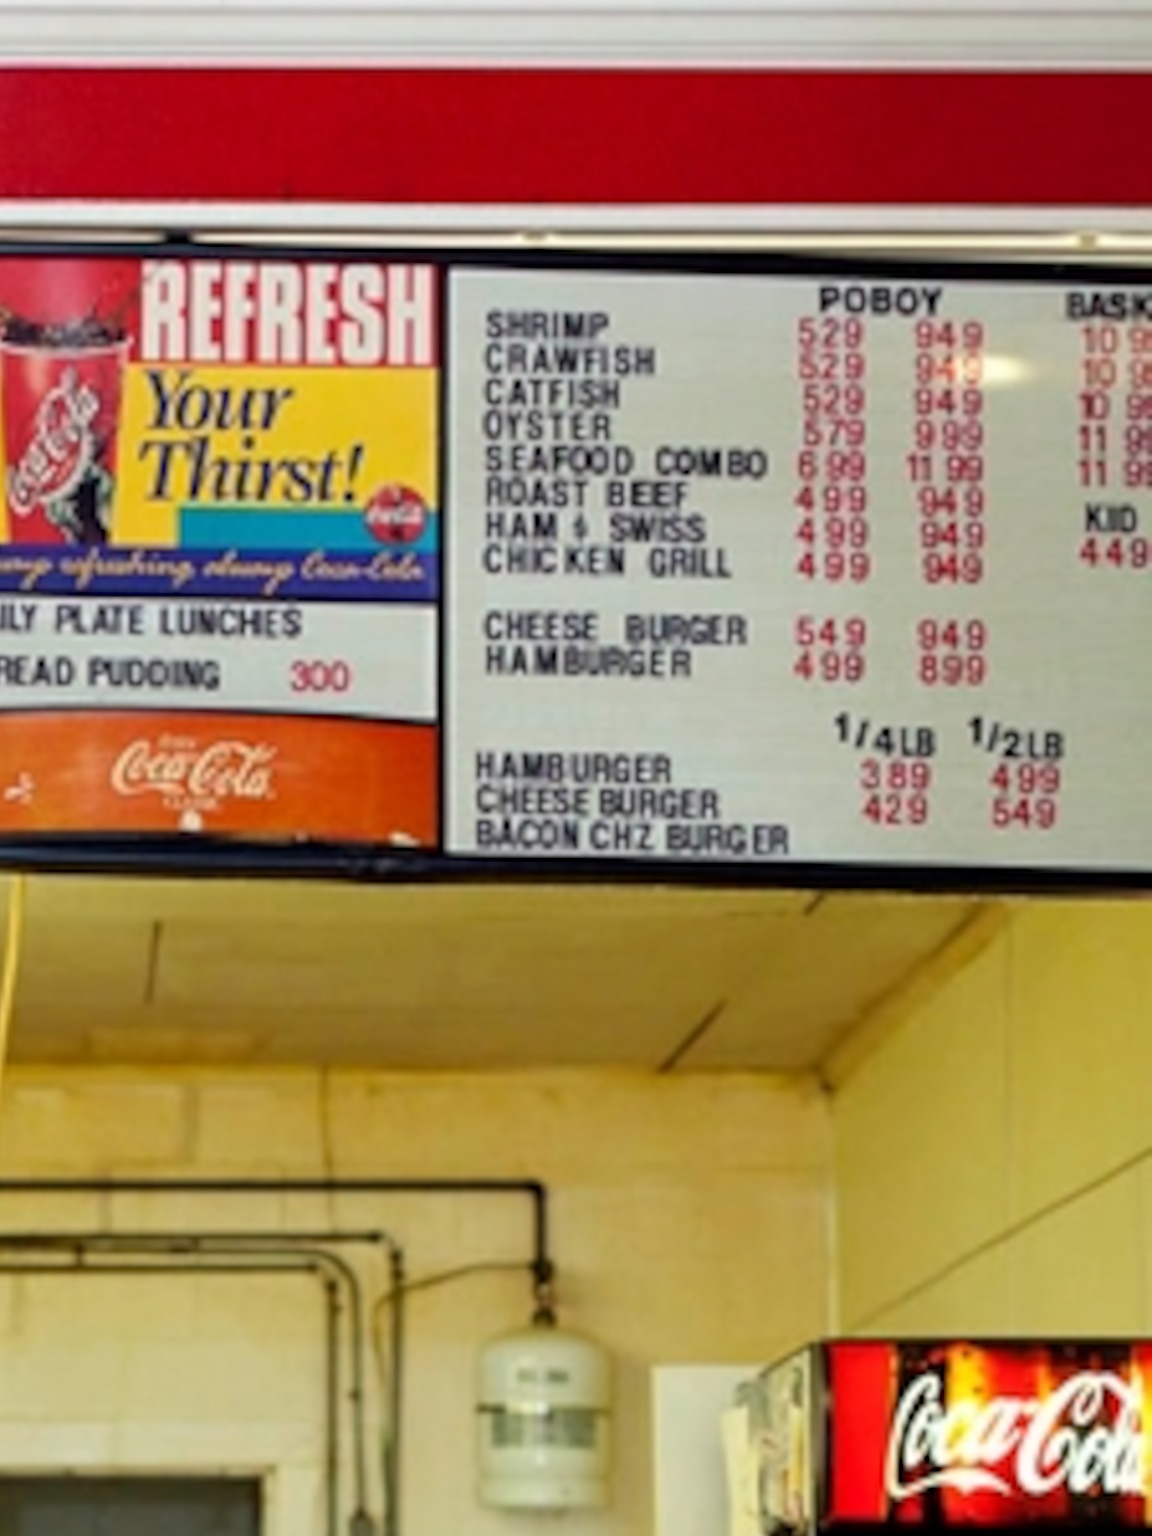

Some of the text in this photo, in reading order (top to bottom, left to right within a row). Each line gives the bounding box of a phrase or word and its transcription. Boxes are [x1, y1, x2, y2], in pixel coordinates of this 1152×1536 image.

[141, 260, 434, 366] REFRESH
[819, 286, 943, 316] POBOY
[485, 311, 610, 339] SHRIMP
[797, 317, 864, 350] 529
[914, 320, 984, 350] 949
[484, 343, 656, 376] CRAWFISH
[144, 370, 294, 432] Your
[484, 378, 621, 408] CATFISH
[914, 389, 984, 415] 949
[483, 409, 612, 441] OYSTER
[139, 436, 364, 504] Thirst!
[485, 445, 635, 476] SEAFOOD
[654, 446, 768, 479] COMBO
[797, 450, 866, 482] 699
[485, 475, 984, 518] ROAST BEEF 499 949
[485, 512, 558, 540] HAM
[609, 513, 706, 543] SWISS
[796, 517, 868, 549] 499
[919, 520, 984, 550] 949
[483, 543, 984, 585] CHICKEN GRILL 499 949
[55, 604, 144, 635] PLATE
[159, 606, 303, 638] LUNCHES
[483, 611, 987, 652] CHEESE BURGER 549 949
[87, 658, 221, 691] PUDDING
[290, 660, 352, 692] 300
[485, 646, 693, 679] HAMBURGER
[793, 651, 865, 682] 499
[860, 758, 932, 790] 389
[989, 762, 1061, 794] 499
[861, 793, 929, 826] 429
[992, 797, 1057, 830] 549
[476, 819, 579, 850] BACON
